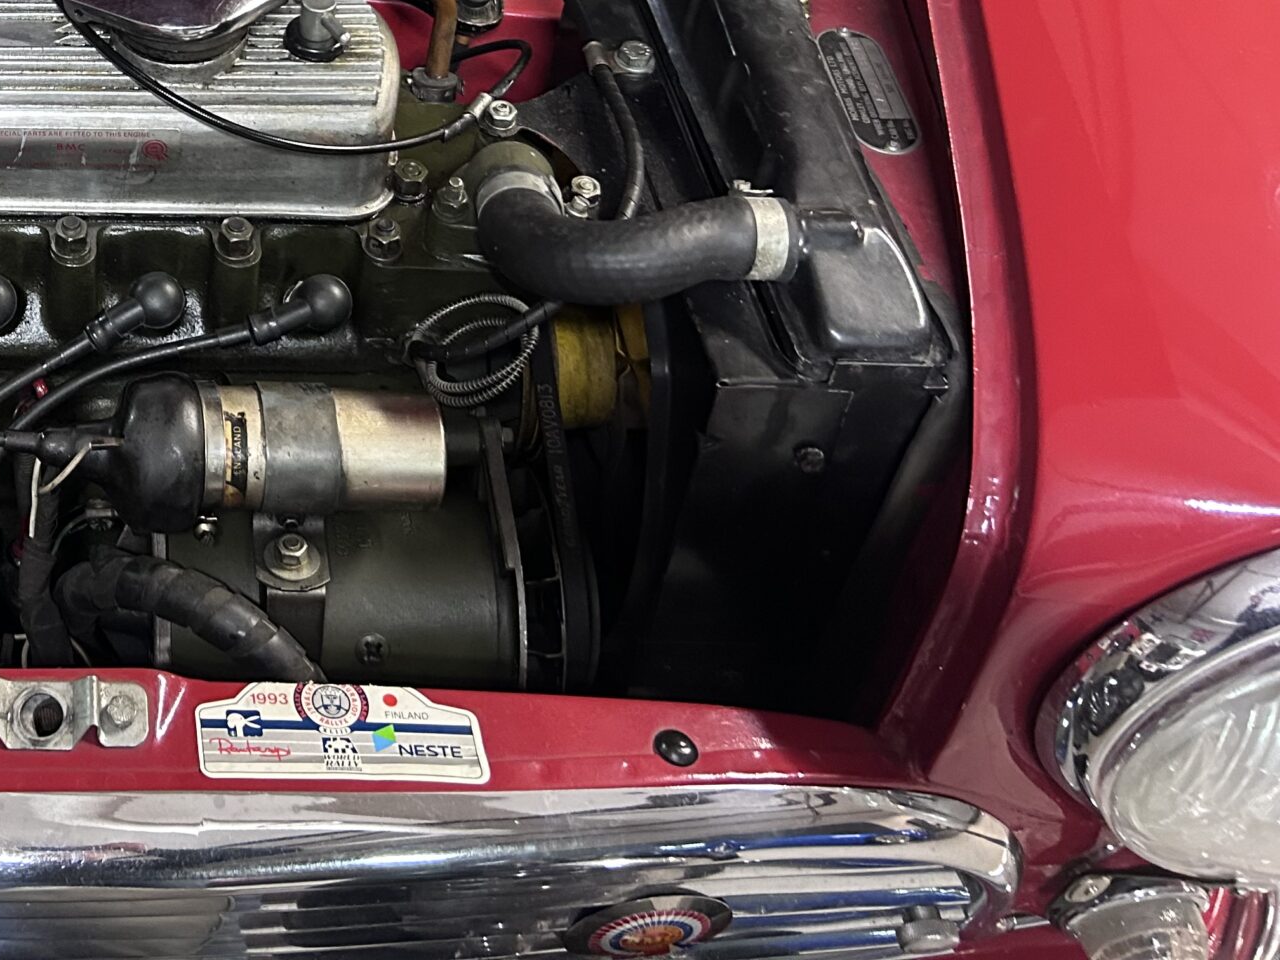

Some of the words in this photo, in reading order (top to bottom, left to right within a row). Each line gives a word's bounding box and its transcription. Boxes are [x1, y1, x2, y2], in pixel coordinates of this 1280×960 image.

[56, 143, 86, 151] BMC
[250, 692, 288, 705] 1993
[385, 711, 429, 720] FINLAND
[398, 744, 463, 758] NESTE
